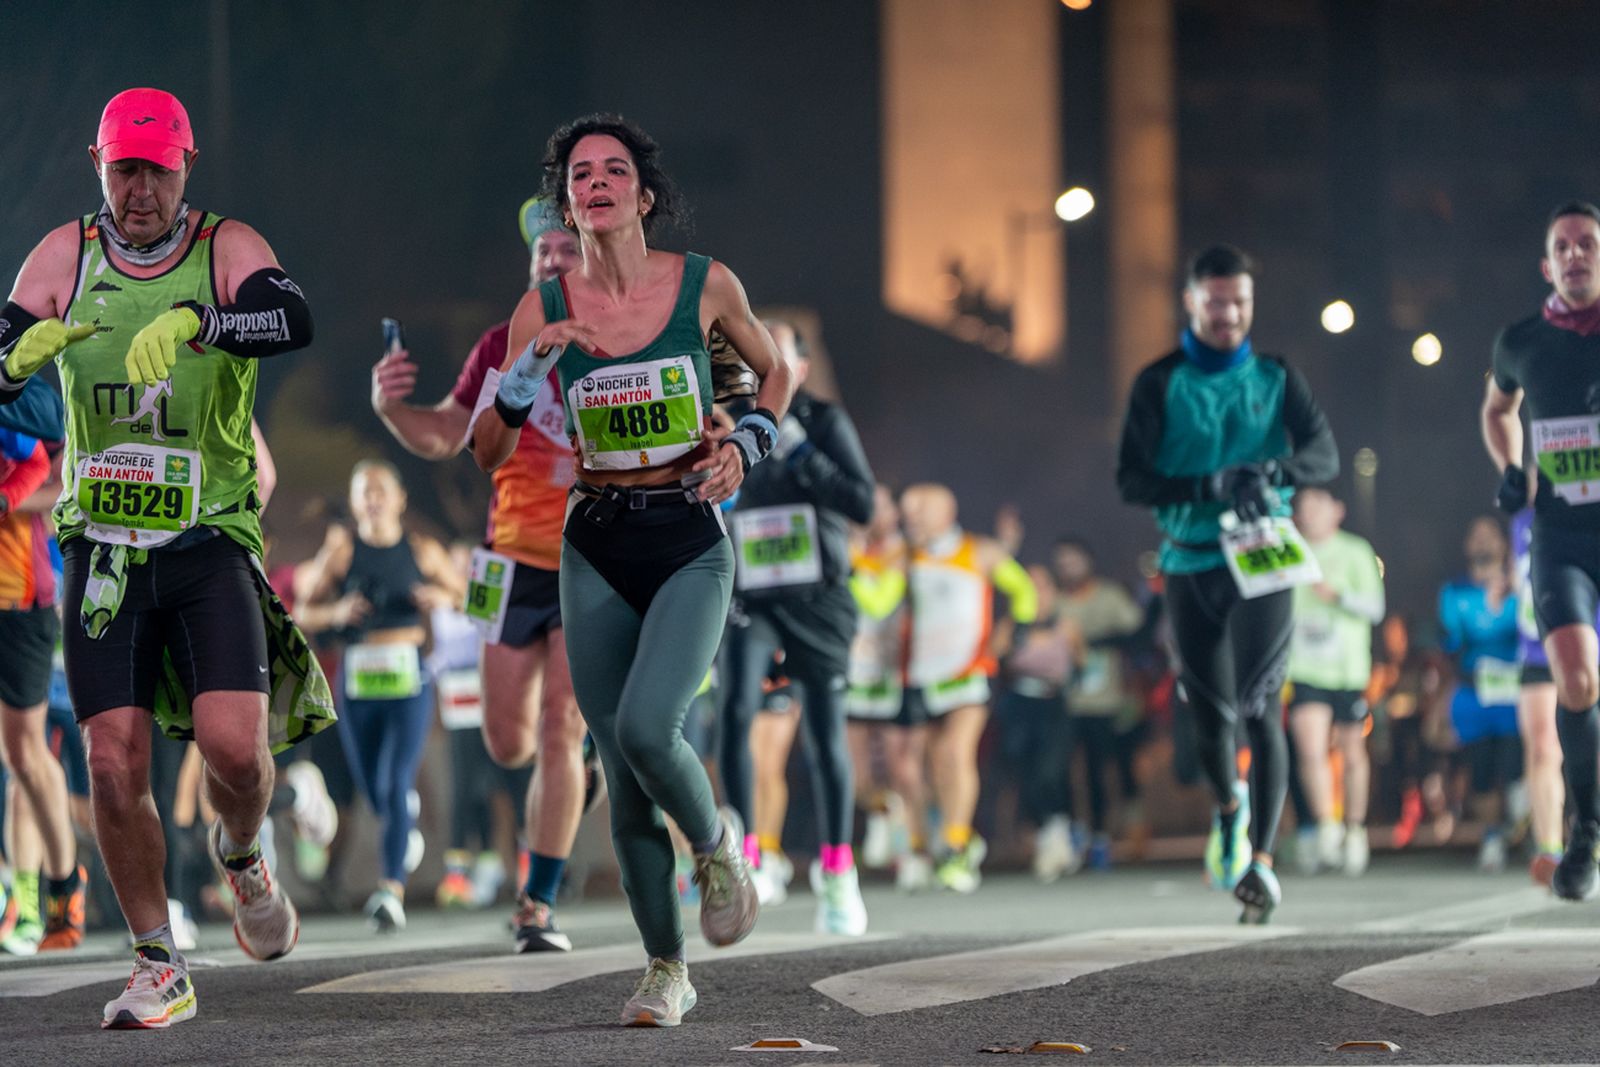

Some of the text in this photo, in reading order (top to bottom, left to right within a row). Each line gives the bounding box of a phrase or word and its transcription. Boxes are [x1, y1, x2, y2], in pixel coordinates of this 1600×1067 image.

[220, 308, 291, 343] Ynsadiet
[585, 395, 608, 408] SAN
[611, 387, 652, 406] ANTÓN
[597, 378, 634, 392] NOCHE
[636, 375, 650, 387] DE
[161, 396, 188, 437] L
[608, 402, 670, 438] 488
[89, 466, 112, 479] SAN
[114, 467, 154, 482] ANTÓN
[103, 454, 138, 467] NOCHE
[140, 456, 155, 468] DE
[89, 482, 184, 519] 13529
